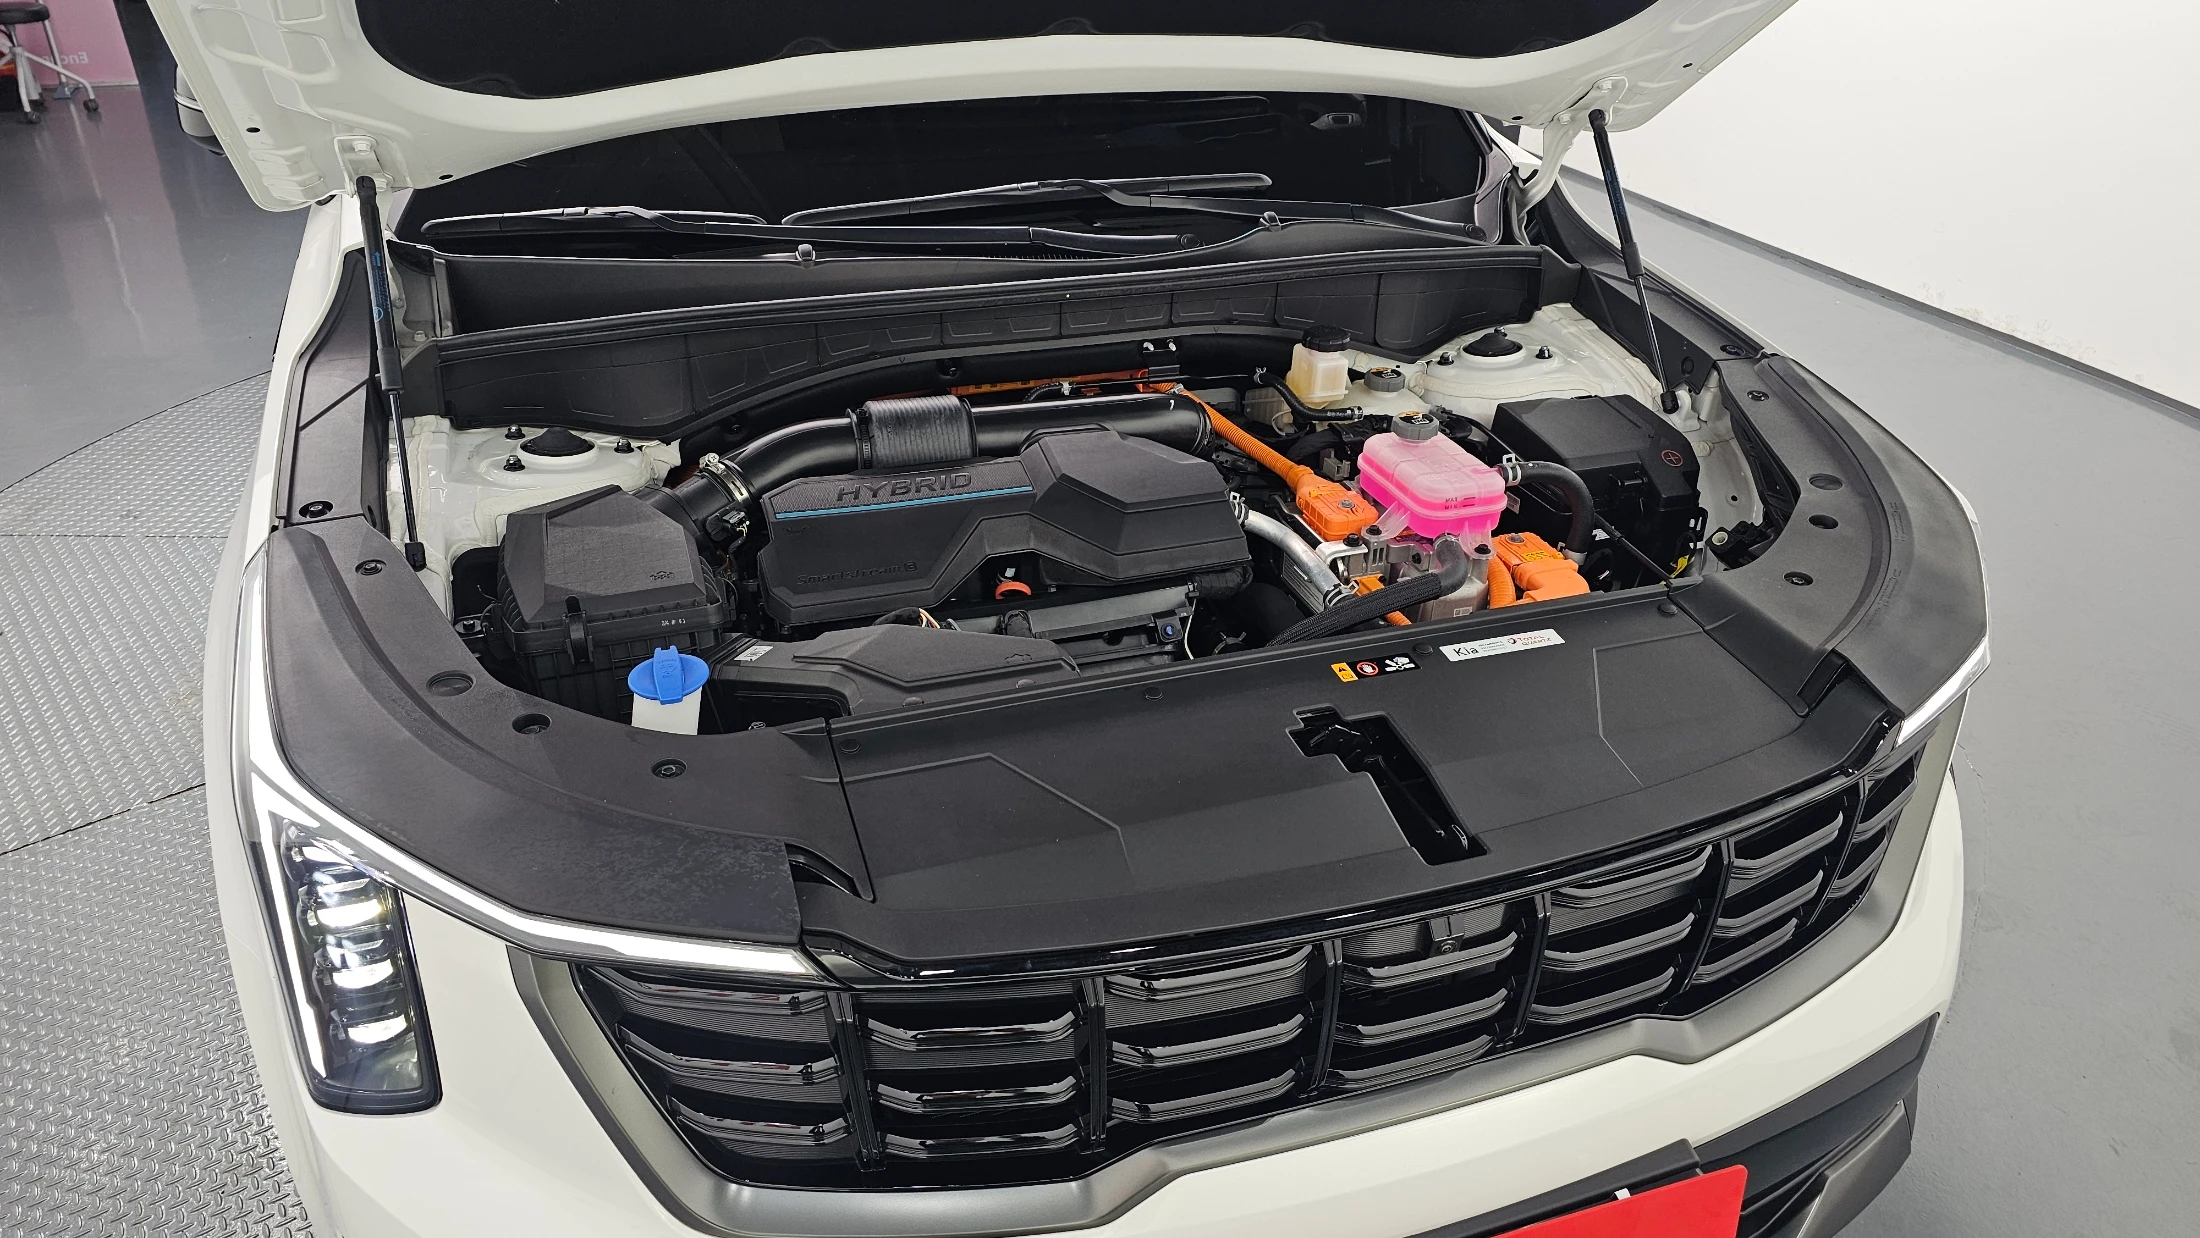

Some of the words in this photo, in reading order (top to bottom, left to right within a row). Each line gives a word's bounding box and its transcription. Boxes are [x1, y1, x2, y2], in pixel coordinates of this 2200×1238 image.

[837, 473, 972, 502] HYBRID
[797, 565, 901, 585] Smartstream
[1453, 646, 1480, 657] Kia
